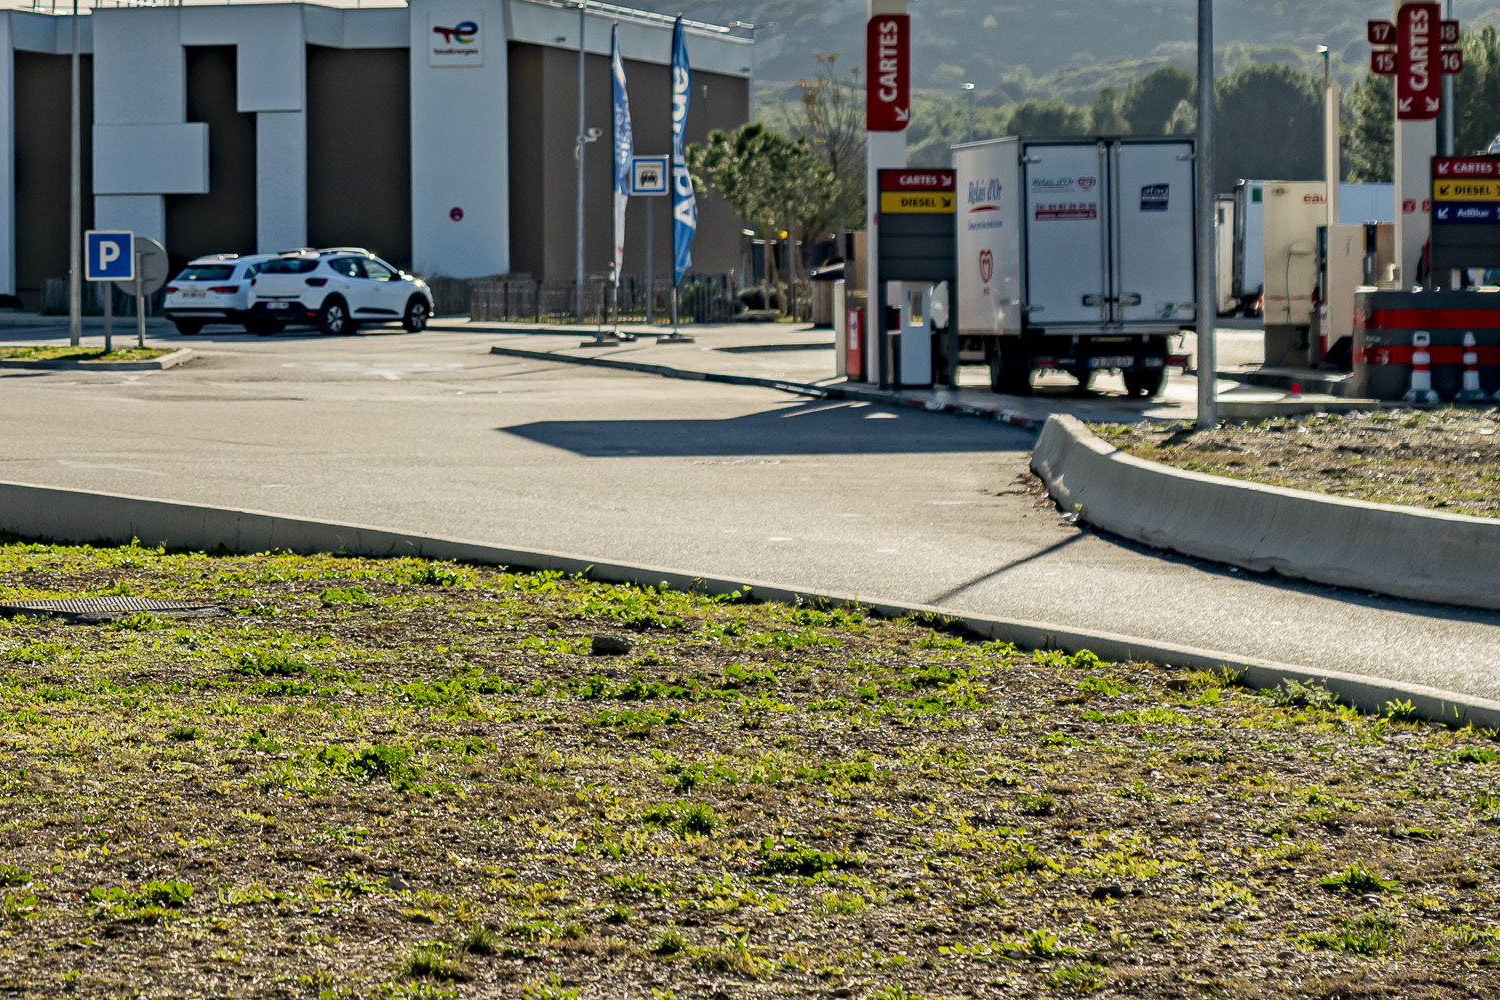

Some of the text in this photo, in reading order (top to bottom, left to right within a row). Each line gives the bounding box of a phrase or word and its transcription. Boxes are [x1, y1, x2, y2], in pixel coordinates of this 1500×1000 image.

[1372, 24, 1391, 41] 17
[1410, 8, 1429, 91] CARTES
[878, 20, 898, 103] CARTES
[1376, 53, 1395, 72] 15
[1441, 53, 1460, 71] 16
[1453, 162, 1493, 174] CARTES
[899, 175, 938, 185] CARTES
[1454, 185, 1491, 195] DIESEL
[901, 198, 936, 207] DIESEL
[100, 241, 121, 271] P
